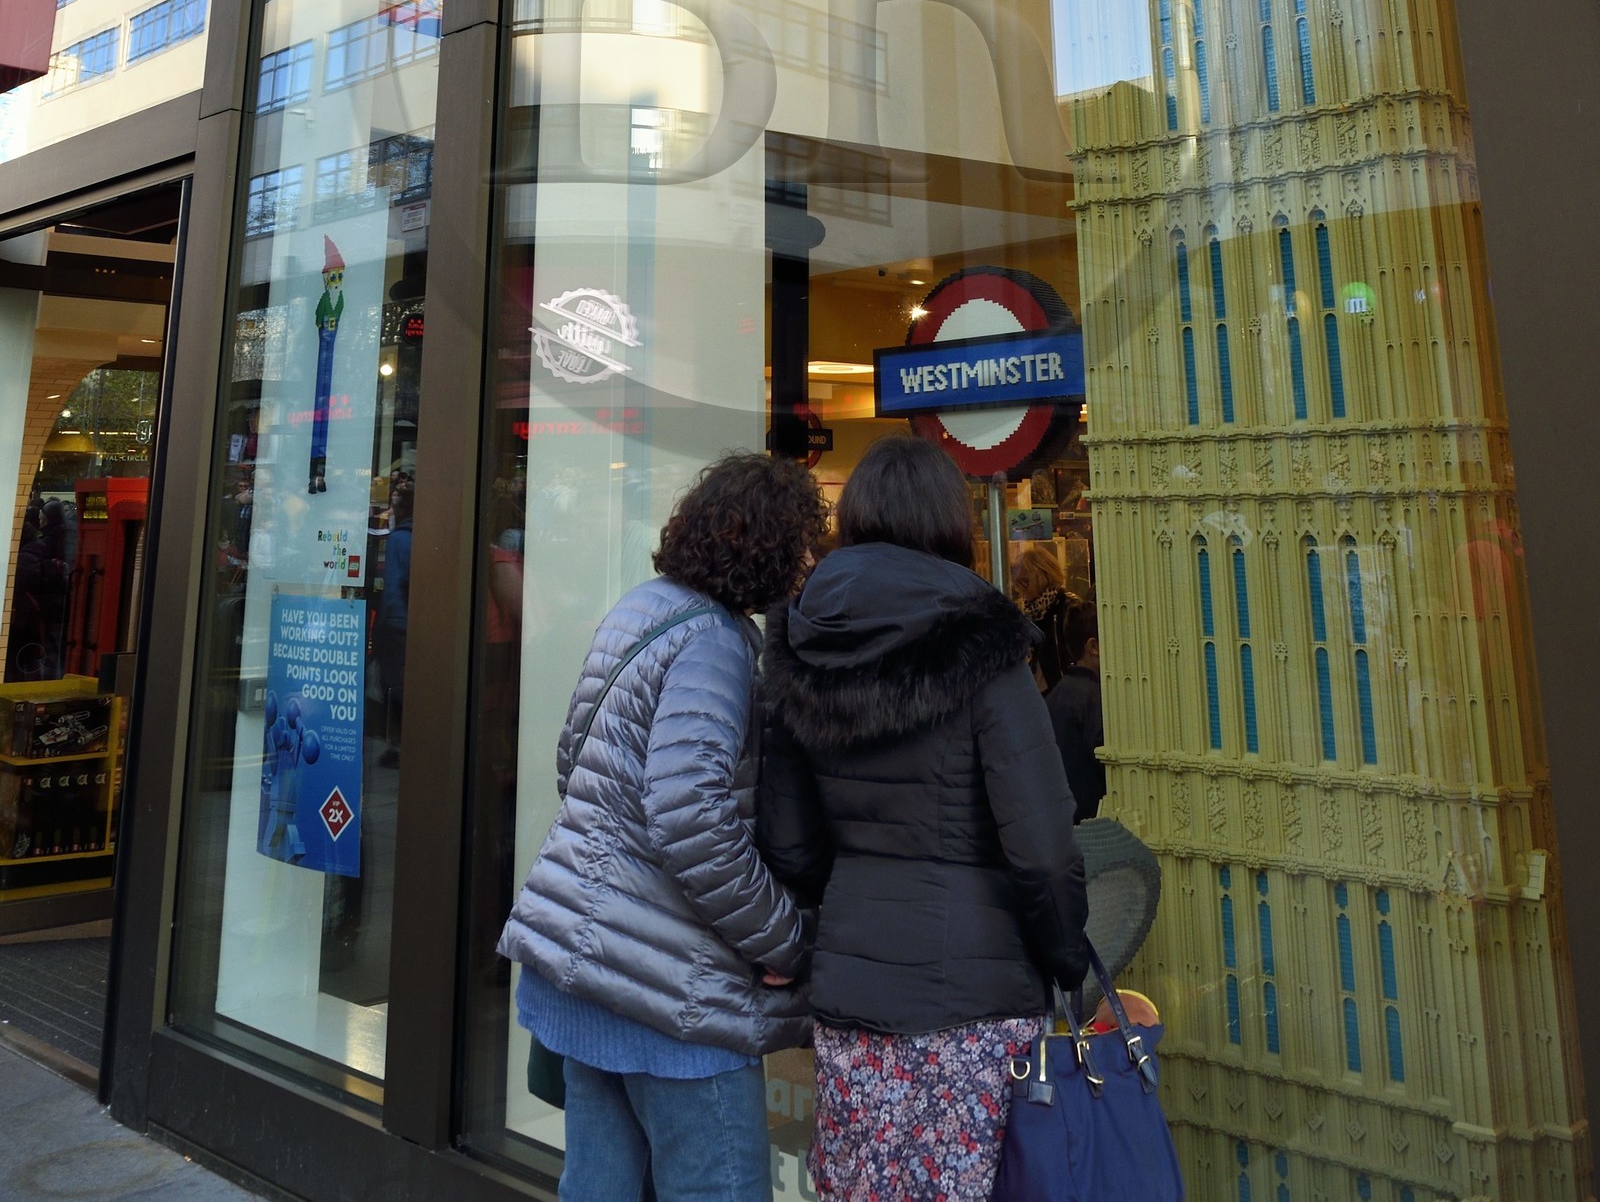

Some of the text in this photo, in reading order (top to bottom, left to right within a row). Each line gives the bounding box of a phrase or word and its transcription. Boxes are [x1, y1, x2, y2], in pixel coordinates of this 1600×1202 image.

[900, 352, 1065, 395] WESTMINSTER
[317, 529, 348, 542] Rebuild
[332, 544, 347, 556] the
[323, 558, 346, 569] world
[281, 609, 359, 629] HAVE YOU BEEN
[280, 625, 359, 647] WORKING OUT?
[273, 643, 358, 666] BECAUSE DOUBLE
[286, 664, 357, 686] POINTS LOOK
[302, 683, 357, 704] GOOD ON
[330, 704, 357, 722] YOU
[328, 808, 344, 824] 2X
